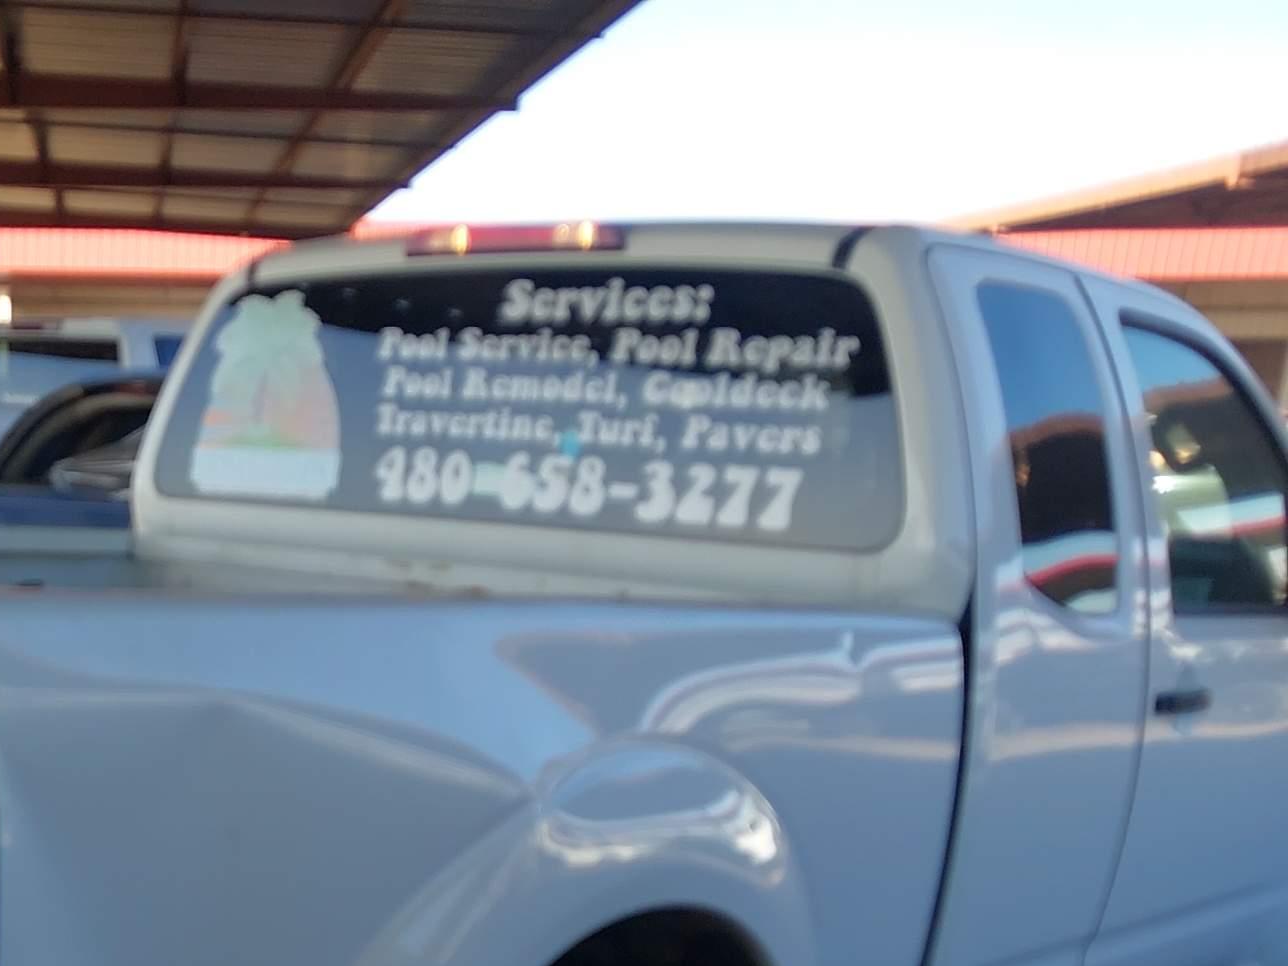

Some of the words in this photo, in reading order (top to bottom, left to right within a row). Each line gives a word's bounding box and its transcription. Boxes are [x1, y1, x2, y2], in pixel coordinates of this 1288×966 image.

[500, 276, 715, 324] Services:
[377, 326, 450, 361] Pool
[457, 326, 599, 369] Service,
[611, 327, 699, 367] Pool
[705, 327, 861, 373] Repair
[382, 364, 453, 400] Pool
[462, 365, 627, 410] Remodel,
[376, 403, 563, 448] Travertine,
[577, 410, 666, 453] Turf,
[682, 414, 822, 455] Pavers
[374, 446, 804, 530] 480-658-3277
